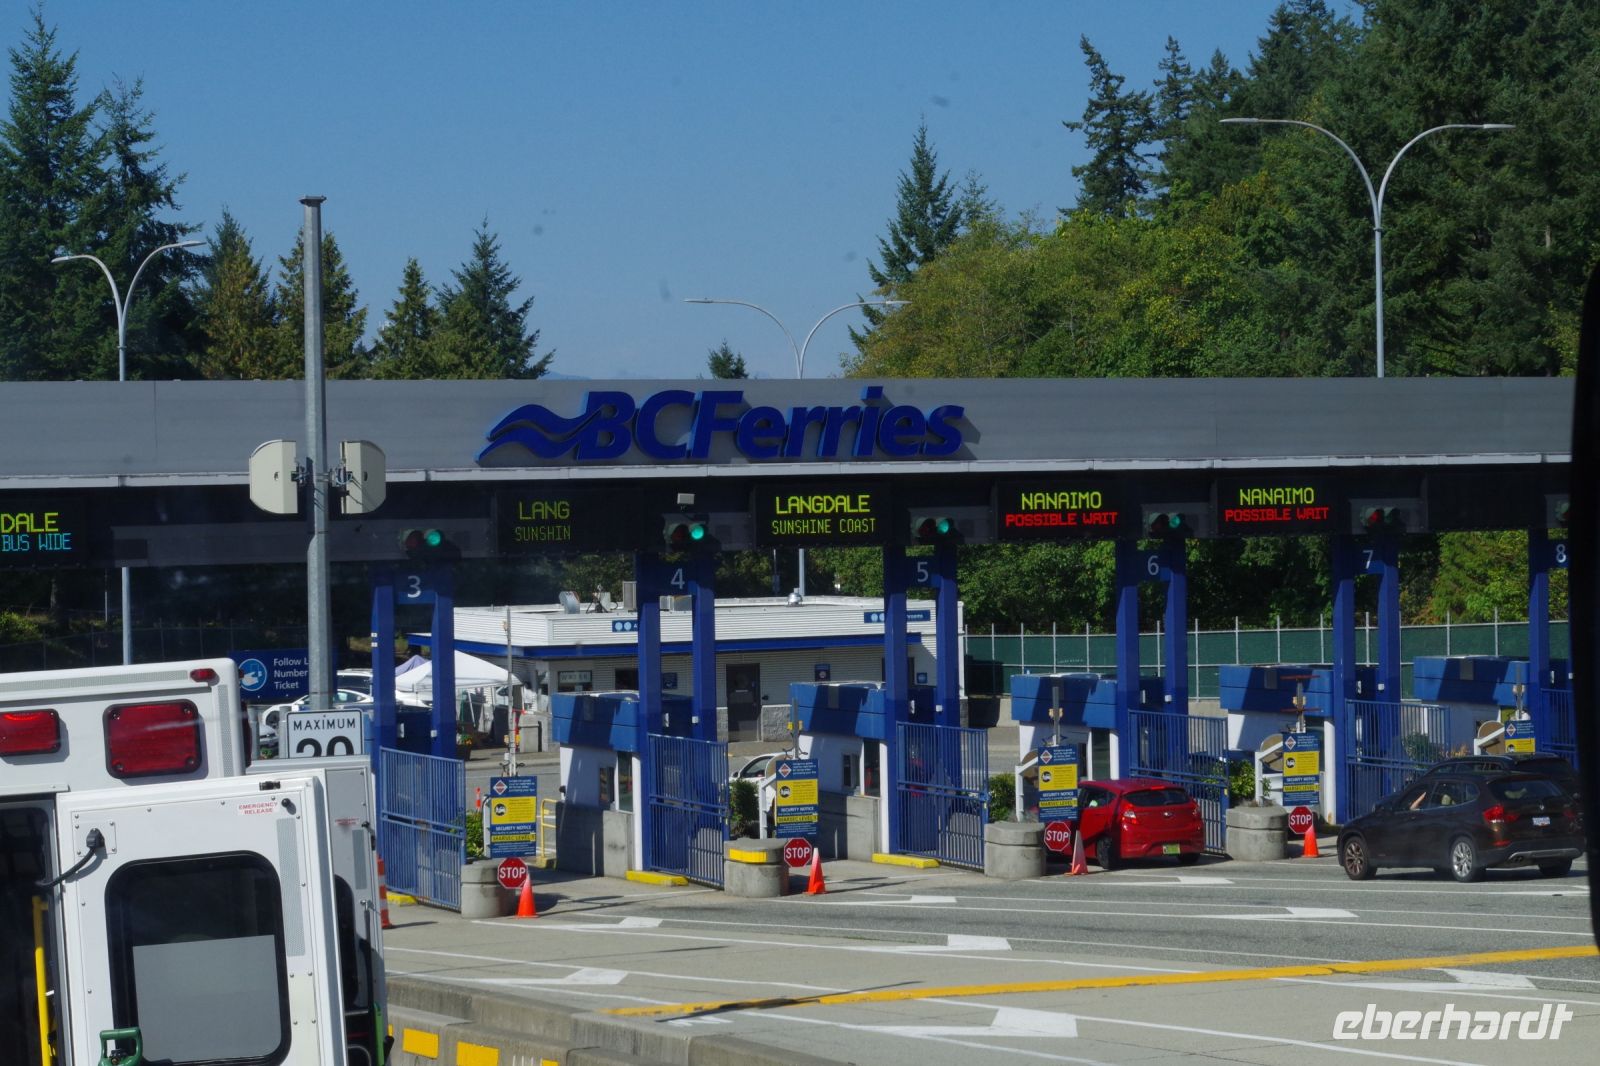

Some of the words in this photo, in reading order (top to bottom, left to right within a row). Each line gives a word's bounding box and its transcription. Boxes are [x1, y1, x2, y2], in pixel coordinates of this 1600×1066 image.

[775, 494, 870, 514] LANGDALE
[1021, 491, 1102, 510] NANAIMO
[1239, 487, 1315, 505] NANAIMO
[518, 501, 571, 520] LANG
[1005, 513, 1077, 527] POSSIBLE
[1083, 511, 1118, 525] WAIT
[1225, 508, 1291, 522] POSSIBLE
[1296, 507, 1329, 520] WAIT
[1, 512, 58, 532] DALE
[772, 519, 831, 535] SUNSHINE
[839, 518, 876, 533] COAST
[514, 525, 571, 541] SUNSHIN
[2, 533, 30, 552] BUS
[38, 532, 72, 550] WIDE
[1362, 549, 1374, 569] 7
[1556, 544, 1567, 563] 8
[916, 561, 929, 583] 5
[1147, 555, 1160, 576] 6
[407, 575, 422, 598] 3
[670, 567, 685, 589] 4
[273, 657, 302, 667] Follow
[273, 668, 309, 679] Number
[274, 681, 300, 690] Ticket
[293, 717, 356, 731] MAXIMUM
[239, 801, 278, 810] EMERGENCY
[1290, 814, 1312, 825] STOP
[1046, 830, 1069, 842] STOP
[786, 847, 810, 859] STOP
[499, 867, 526, 879] STOP
